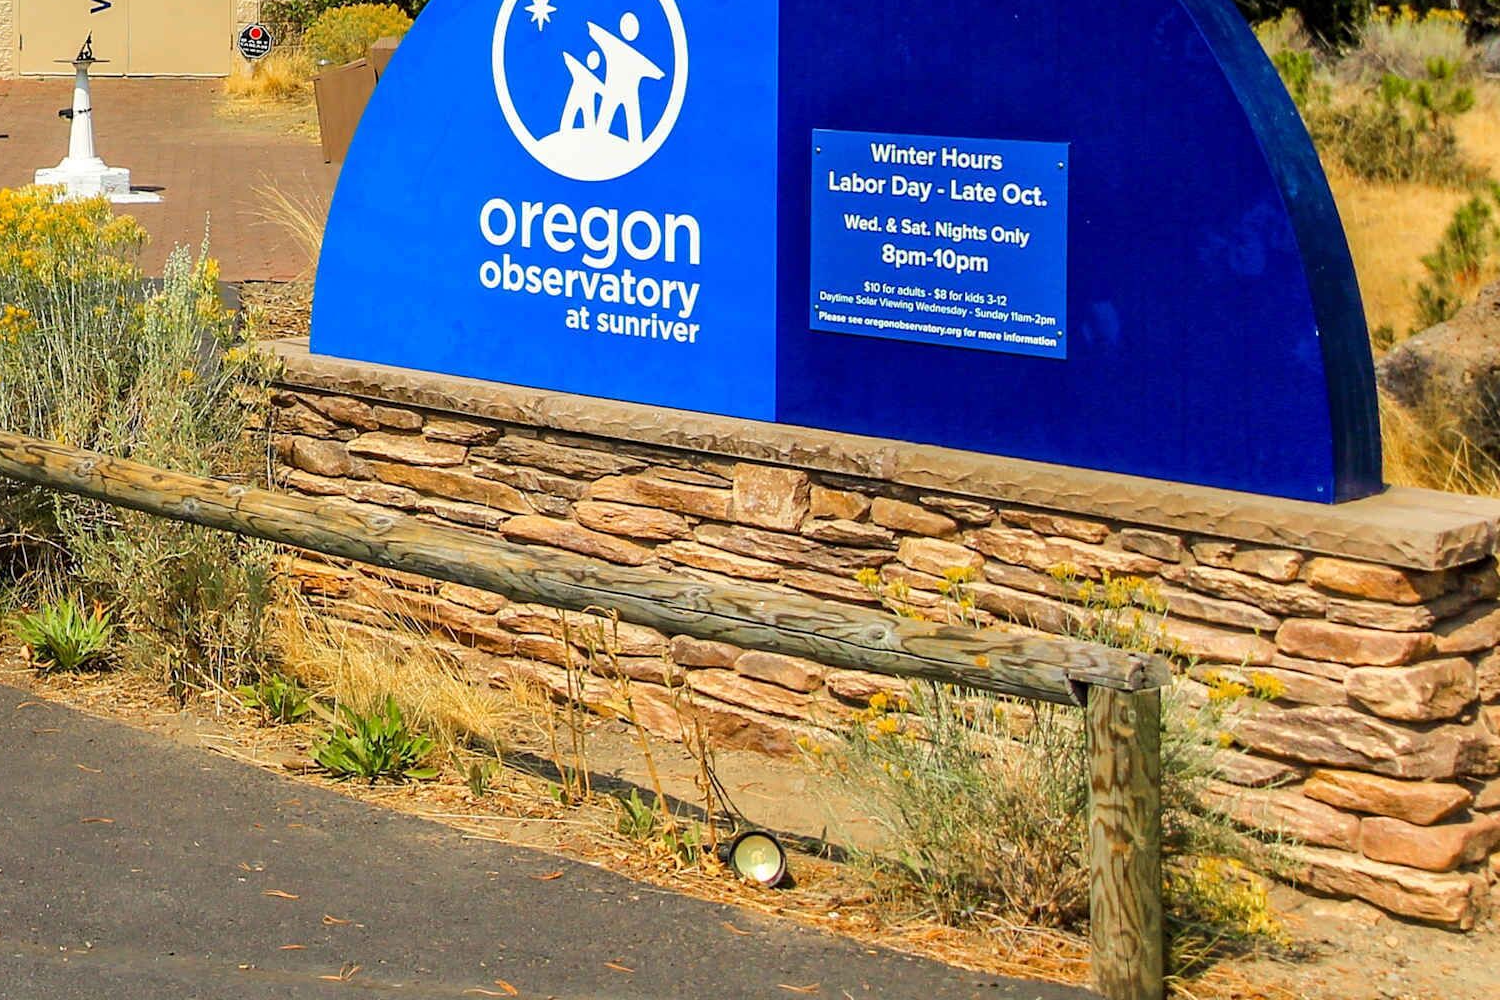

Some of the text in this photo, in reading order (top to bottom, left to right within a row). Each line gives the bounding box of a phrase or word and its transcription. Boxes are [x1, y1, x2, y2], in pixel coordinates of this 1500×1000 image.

[870, 143, 1003, 171] Winter Hours
[828, 171, 886, 195] Labor
[891, 175, 932, 202] Day
[950, 179, 997, 203] Late
[1002, 183, 1048, 207] Oct.
[478, 197, 701, 270] oregon
[844, 214, 1030, 248] Wed. & Sat. Nights Only
[881, 243, 989, 274] 8pm-10pm
[478, 253, 701, 319] observatory
[863, 280, 881, 293] $10
[882, 283, 895, 294] for
[897, 286, 926, 298] adults
[933, 288, 947, 300] $8
[949, 290, 962, 301] for
[964, 292, 985, 304] kids
[986, 294, 1007, 306] 3-12
[565, 306, 700, 344] at sunriver
[819, 291, 854, 304] Daytime
[855, 295, 878, 306] Solar
[879, 298, 914, 312] Viewing
[915, 301, 968, 318] Wednesday
[974, 307, 1009, 322] Sunday
[1010, 311, 1056, 326] 11am-2pm
[819, 311, 1057, 347] Please see oregonobservatory.org for more information
